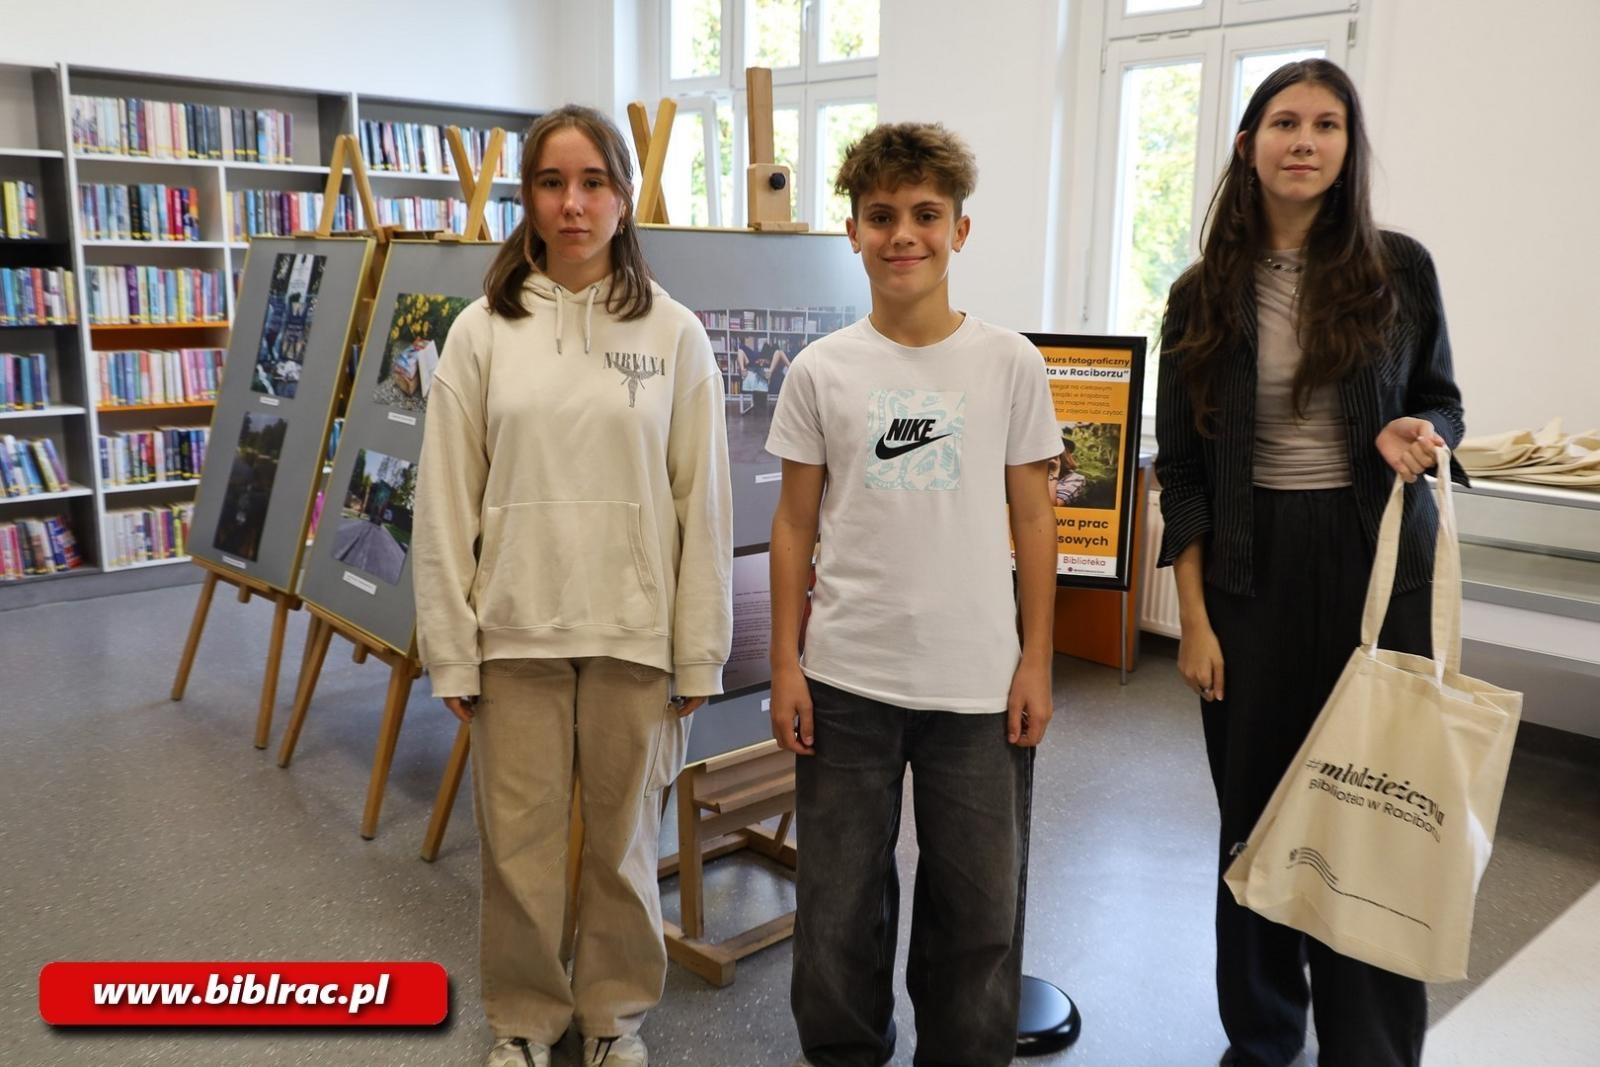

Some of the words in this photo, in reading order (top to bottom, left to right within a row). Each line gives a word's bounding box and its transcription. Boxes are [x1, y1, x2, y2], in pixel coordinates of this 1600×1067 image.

[601, 351, 666, 377] NIRVANA
[1069, 357, 1130, 366] fotograficzny
[886, 418, 936, 441] NIKE
[1057, 518, 1075, 527] wa
[1078, 519, 1109, 530] prac
[1058, 535, 1109, 548] sowych
[1063, 556, 1106, 567] Biblioteka
[1367, 799, 1381, 811] w
